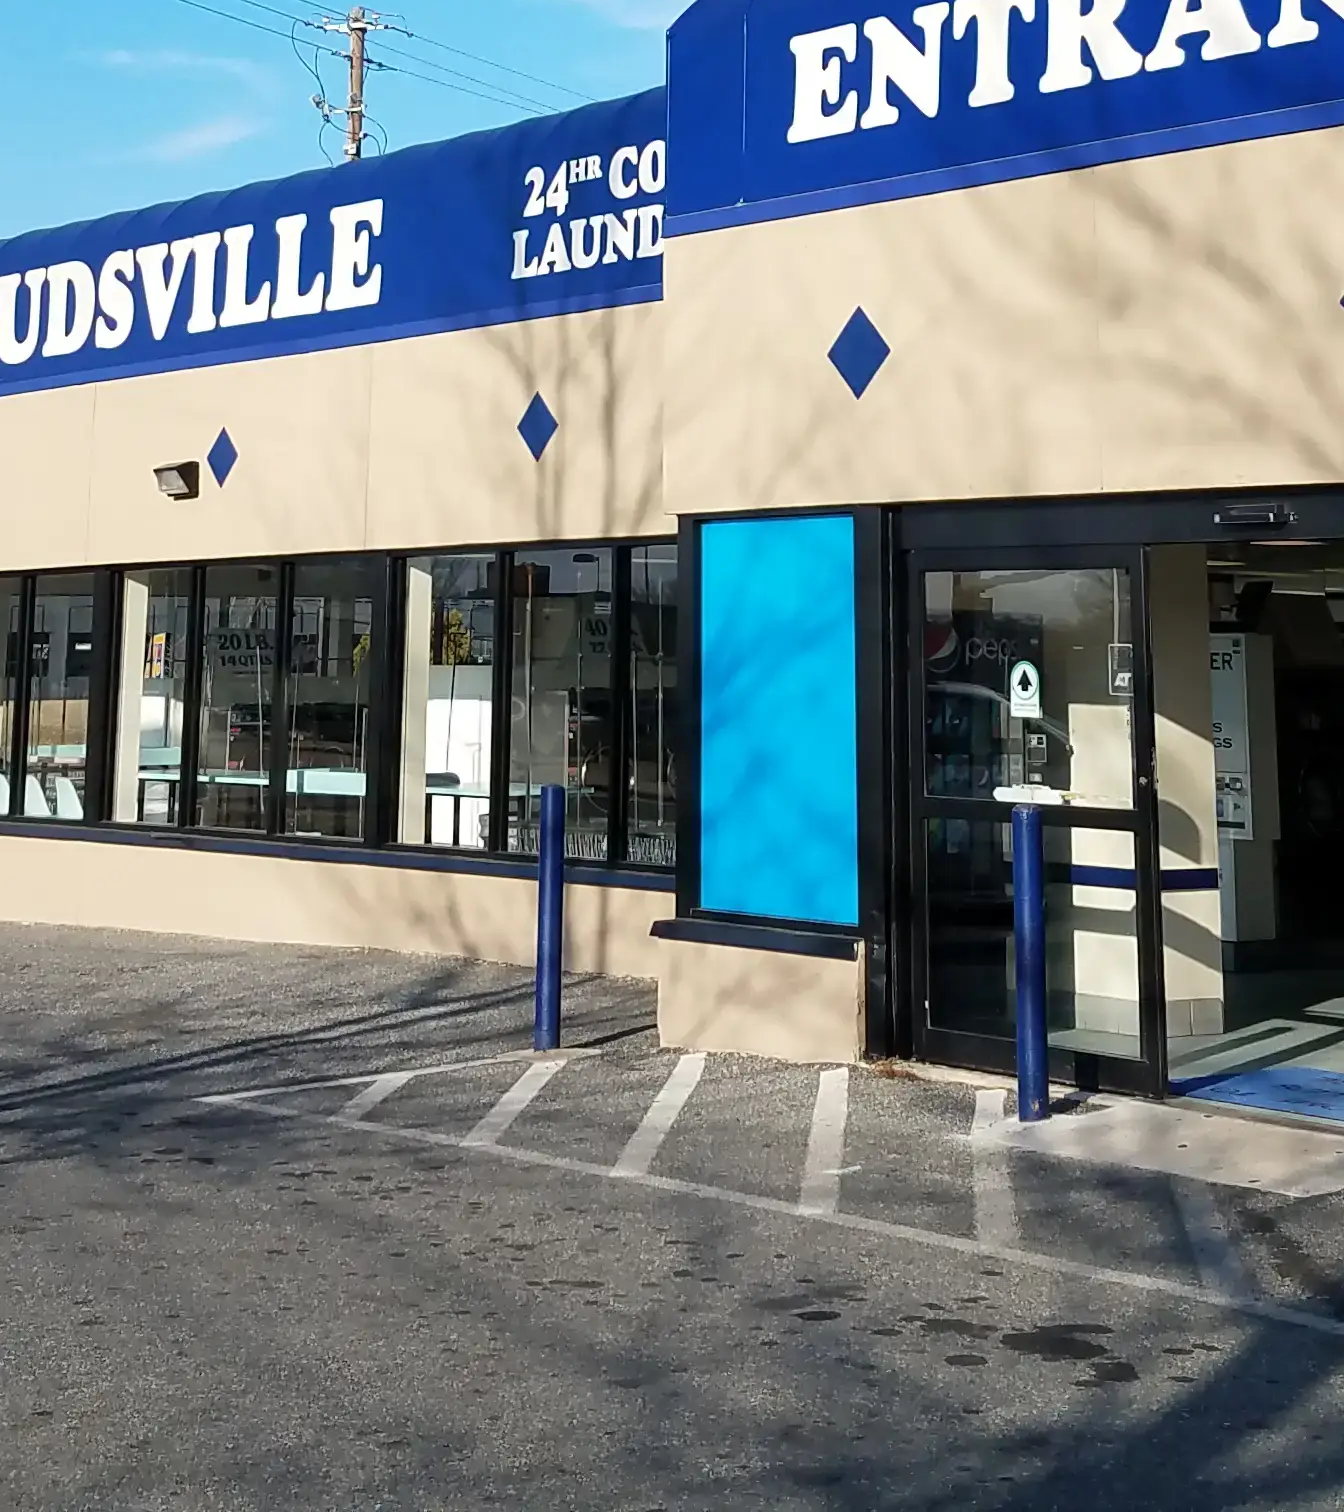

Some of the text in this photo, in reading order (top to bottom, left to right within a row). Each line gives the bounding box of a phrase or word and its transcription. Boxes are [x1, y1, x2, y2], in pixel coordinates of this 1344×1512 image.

[511, 204, 665, 280] LAUND
[218, 633, 242, 651] 20
[1209, 651, 1234, 671] ER
